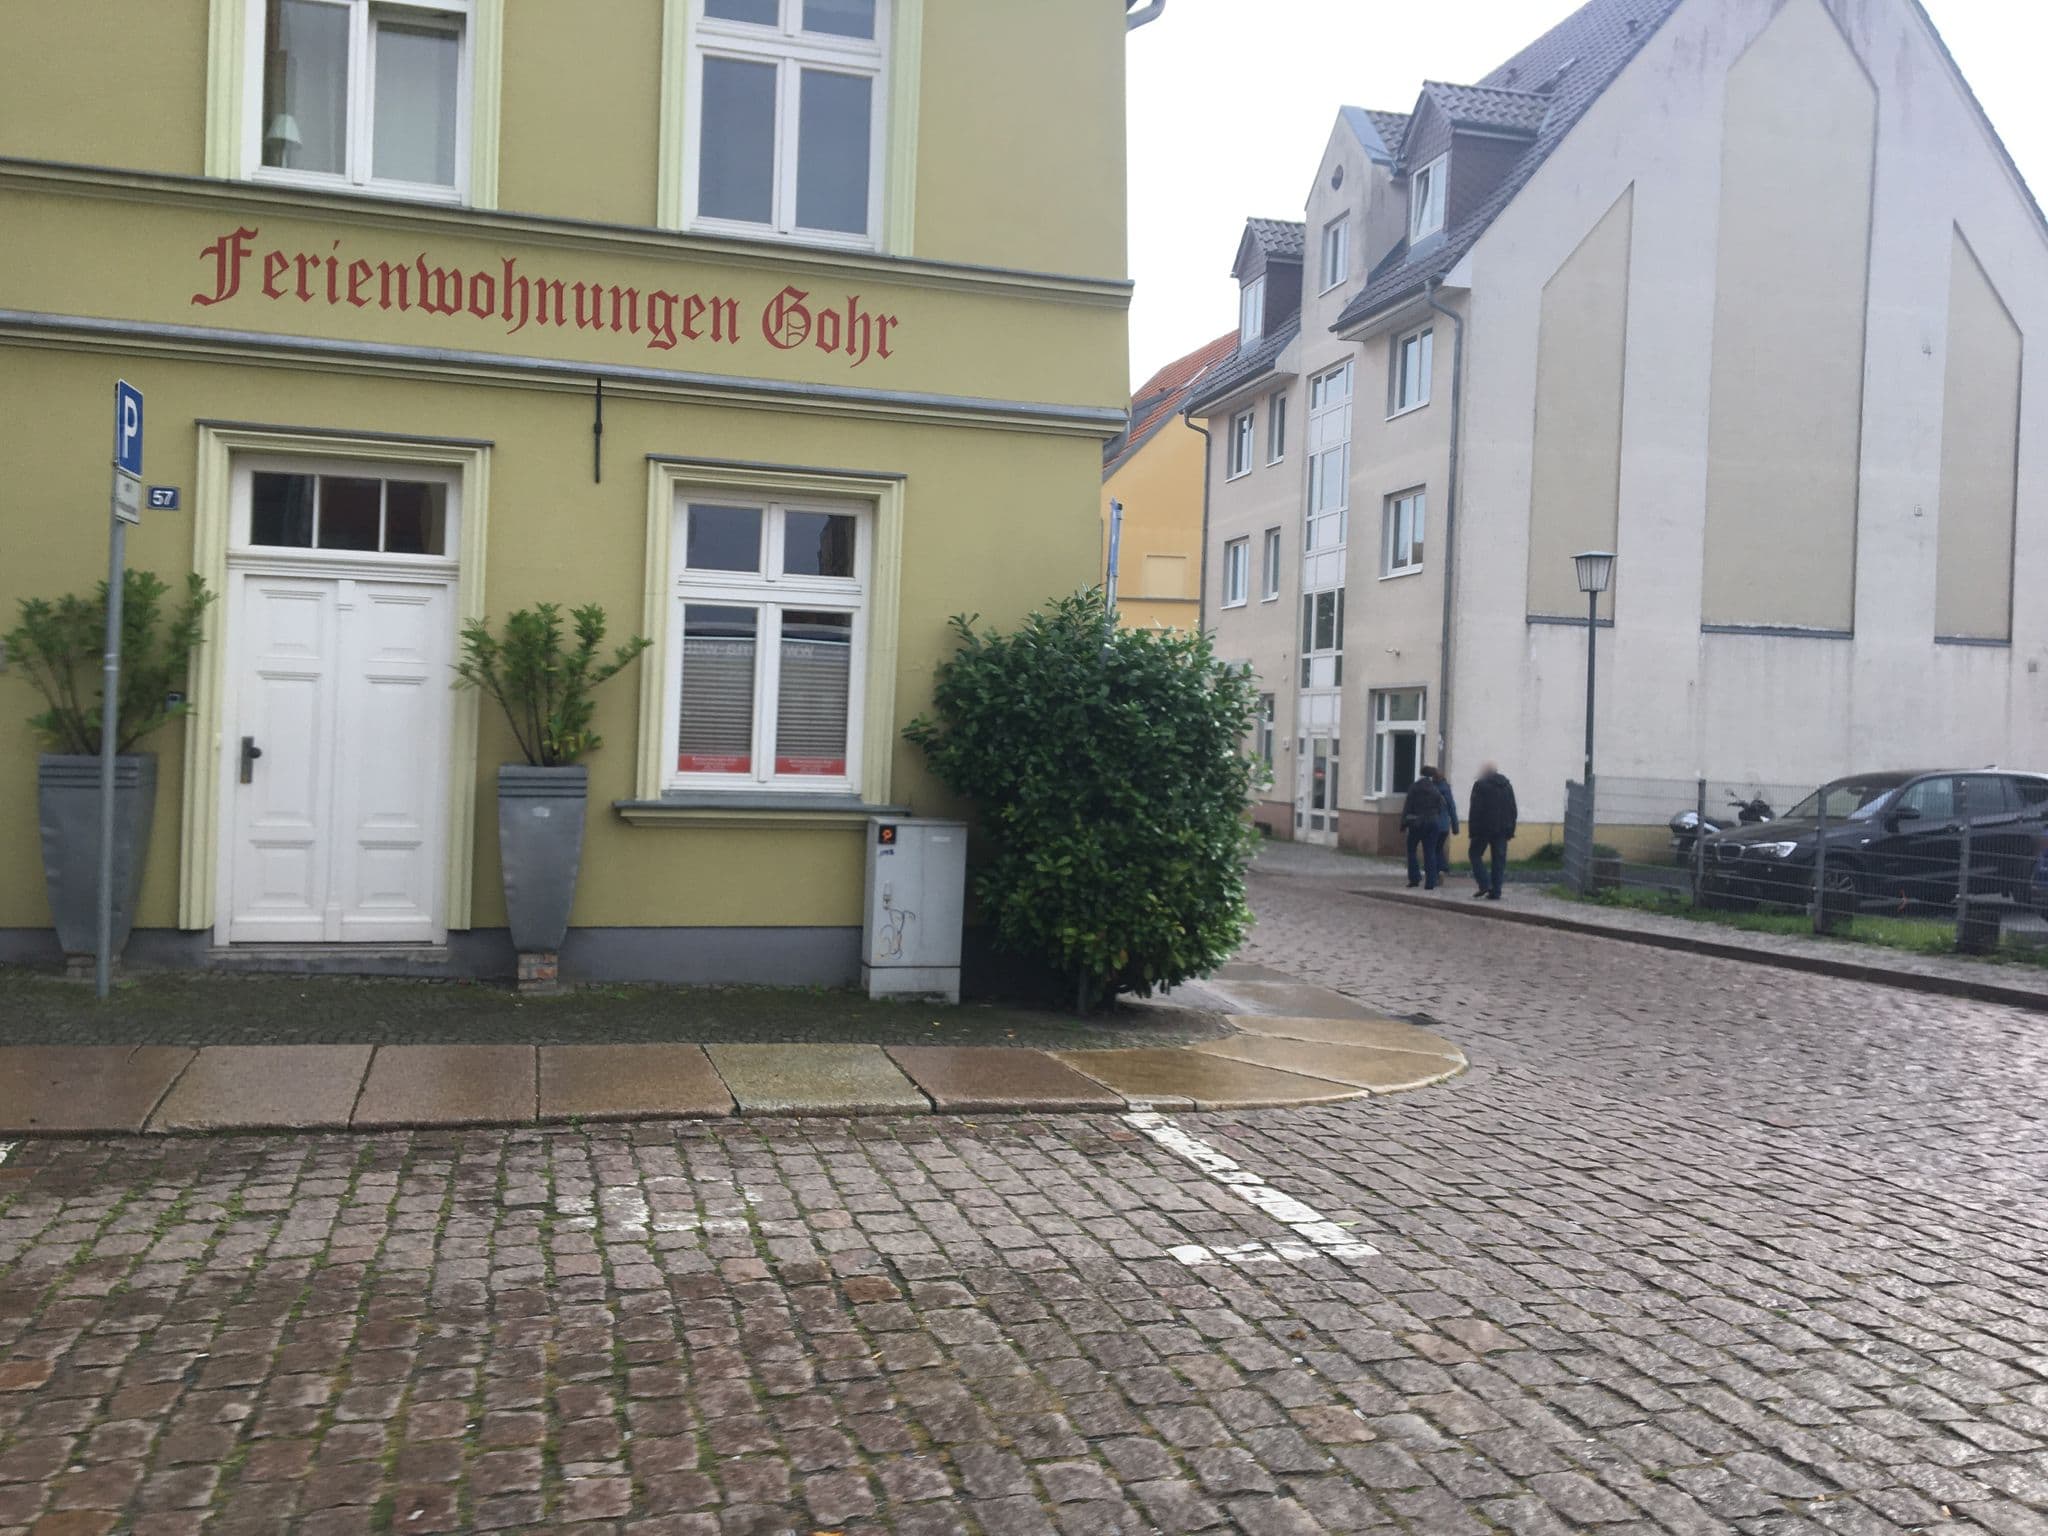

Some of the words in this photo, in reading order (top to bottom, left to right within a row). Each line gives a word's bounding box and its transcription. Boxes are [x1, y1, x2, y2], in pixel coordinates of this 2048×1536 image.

[192, 226, 740, 350] Ferienwohnungen
[760, 284, 898, 368] Gohr
[122, 395, 138, 459] P
[152, 490, 174, 505] 57
